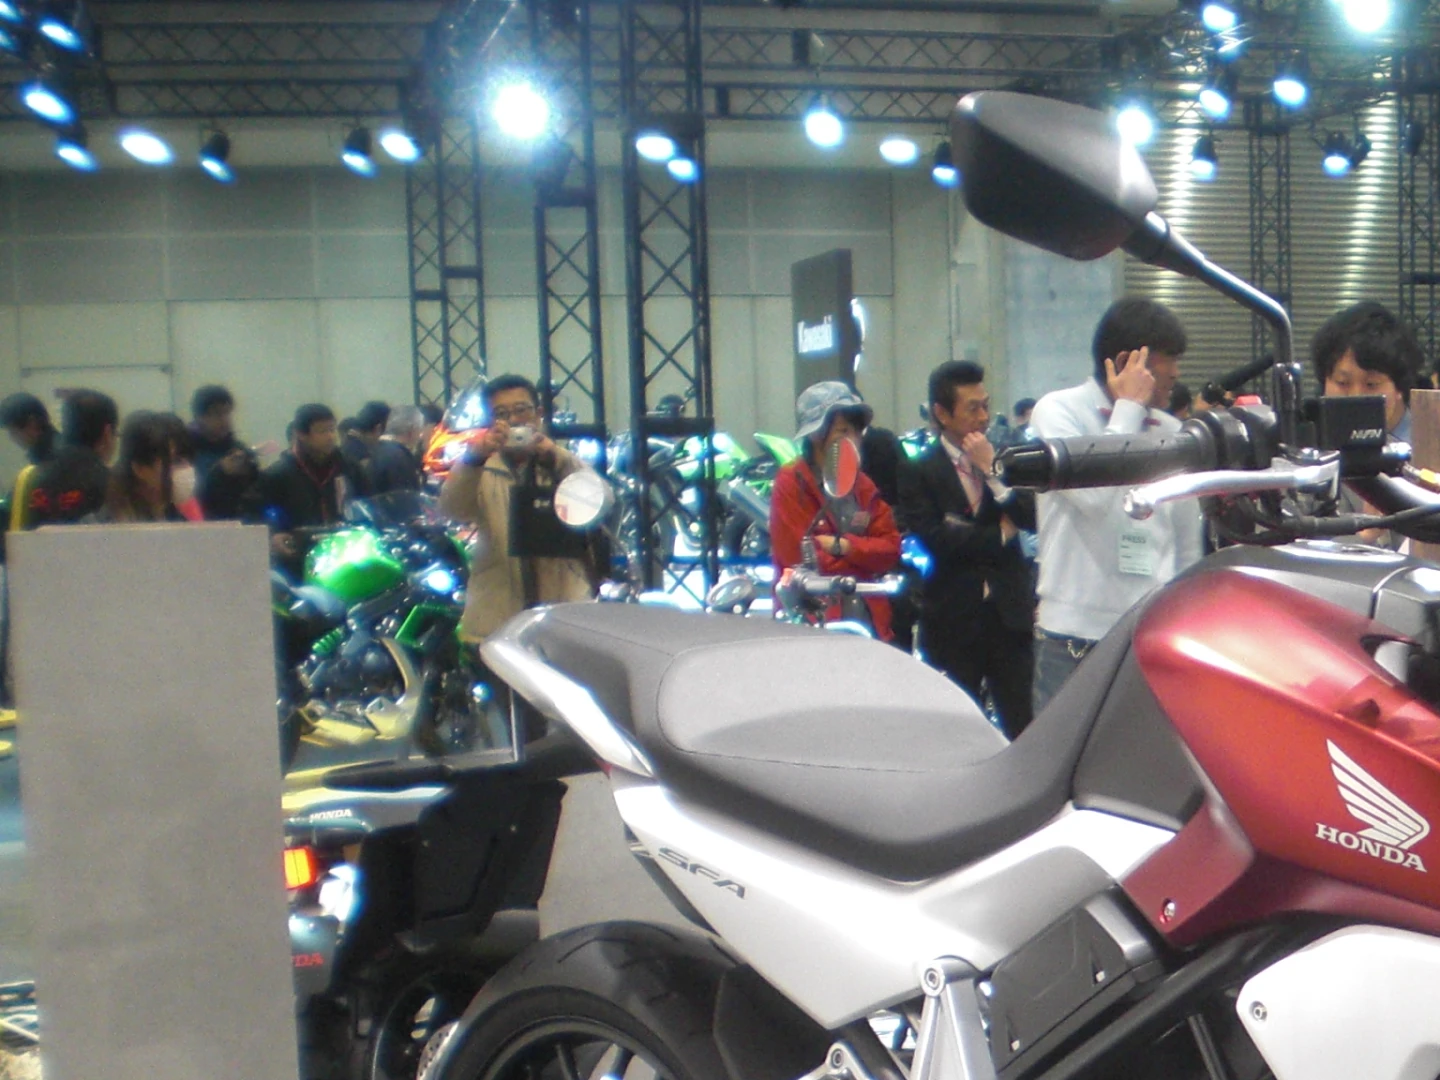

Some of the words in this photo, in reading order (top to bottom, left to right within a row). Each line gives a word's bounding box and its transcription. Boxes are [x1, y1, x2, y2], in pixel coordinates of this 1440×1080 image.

[308, 808, 353, 823] HONDA
[658, 847, 746, 899] SFA
[1315, 822, 1428, 873] HONDA
